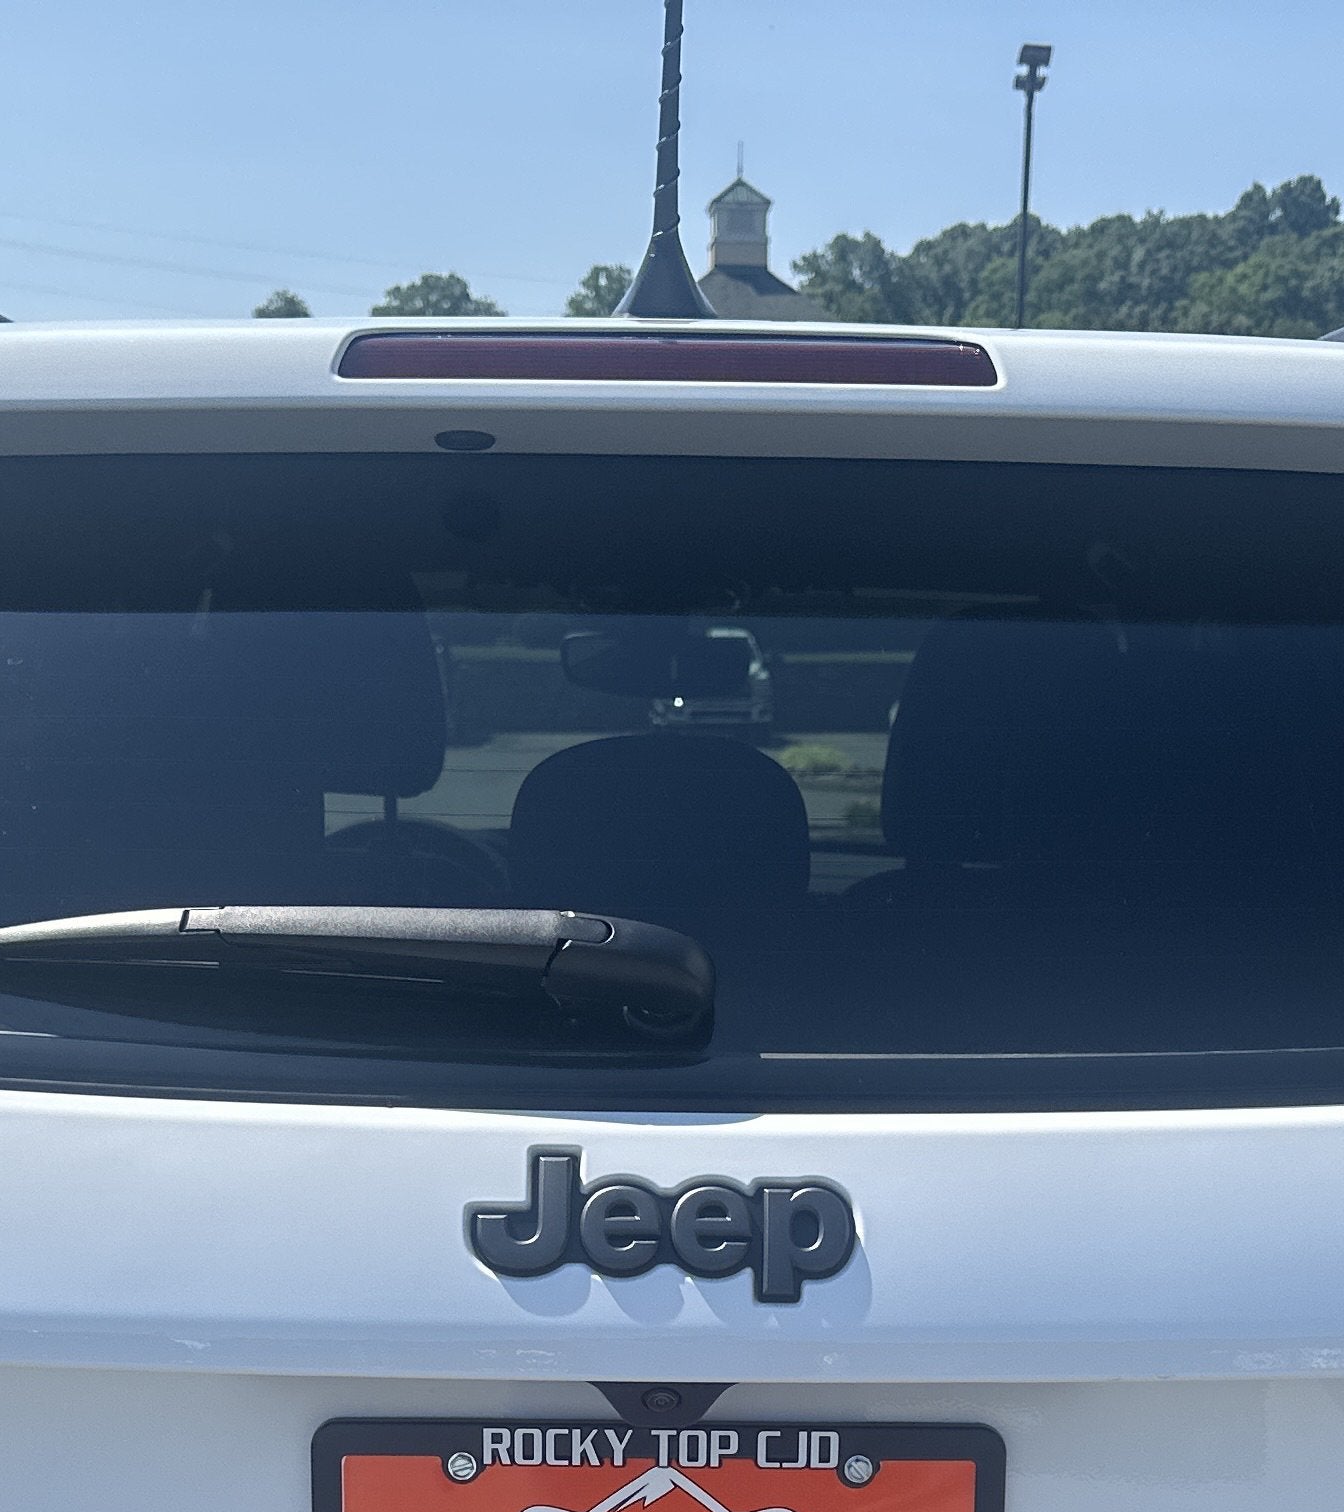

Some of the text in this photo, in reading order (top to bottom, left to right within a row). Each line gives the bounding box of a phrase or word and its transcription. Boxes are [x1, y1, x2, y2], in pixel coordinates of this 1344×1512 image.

[465, 1146, 856, 1303] Jeep
[482, 1428, 840, 1469] ROCKY TOP CJD
